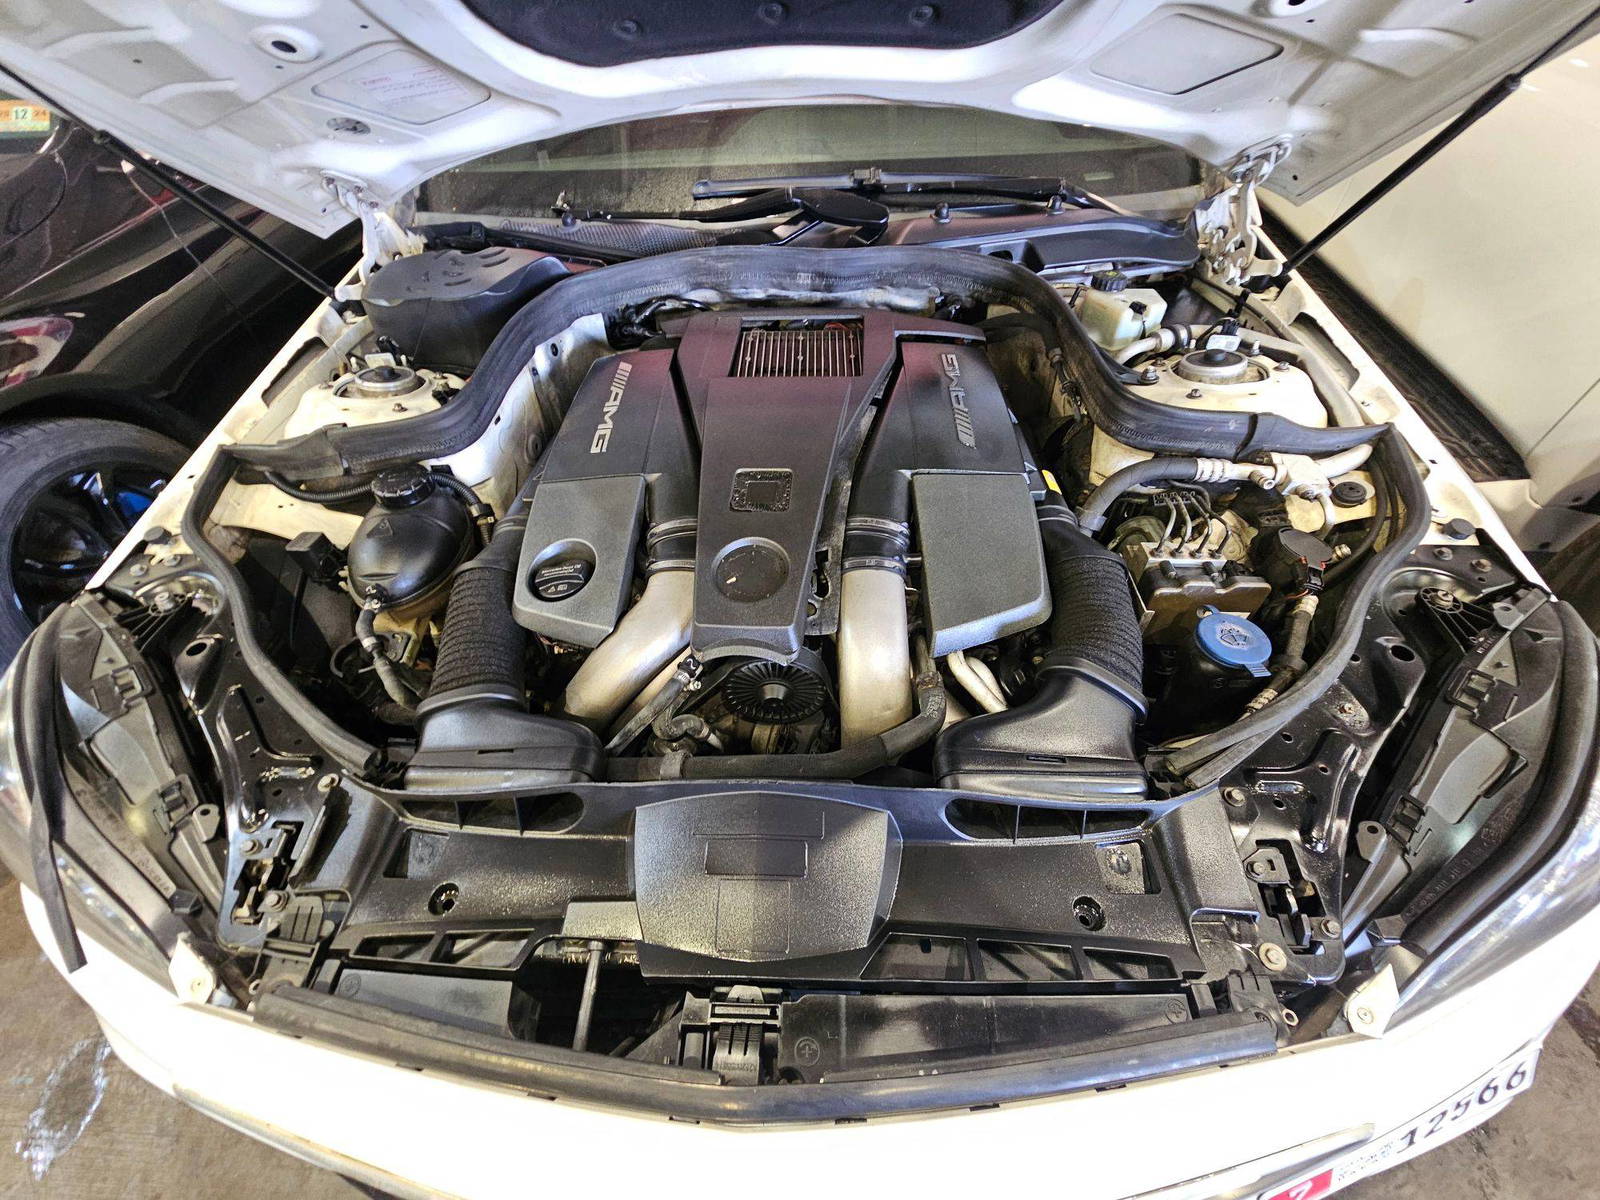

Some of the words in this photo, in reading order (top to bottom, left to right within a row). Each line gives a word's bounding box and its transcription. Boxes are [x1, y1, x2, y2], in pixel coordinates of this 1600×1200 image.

[14, 108, 28, 120] 12
[590, 385, 624, 454] AMG
[1397, 1060, 1527, 1154] 12566
